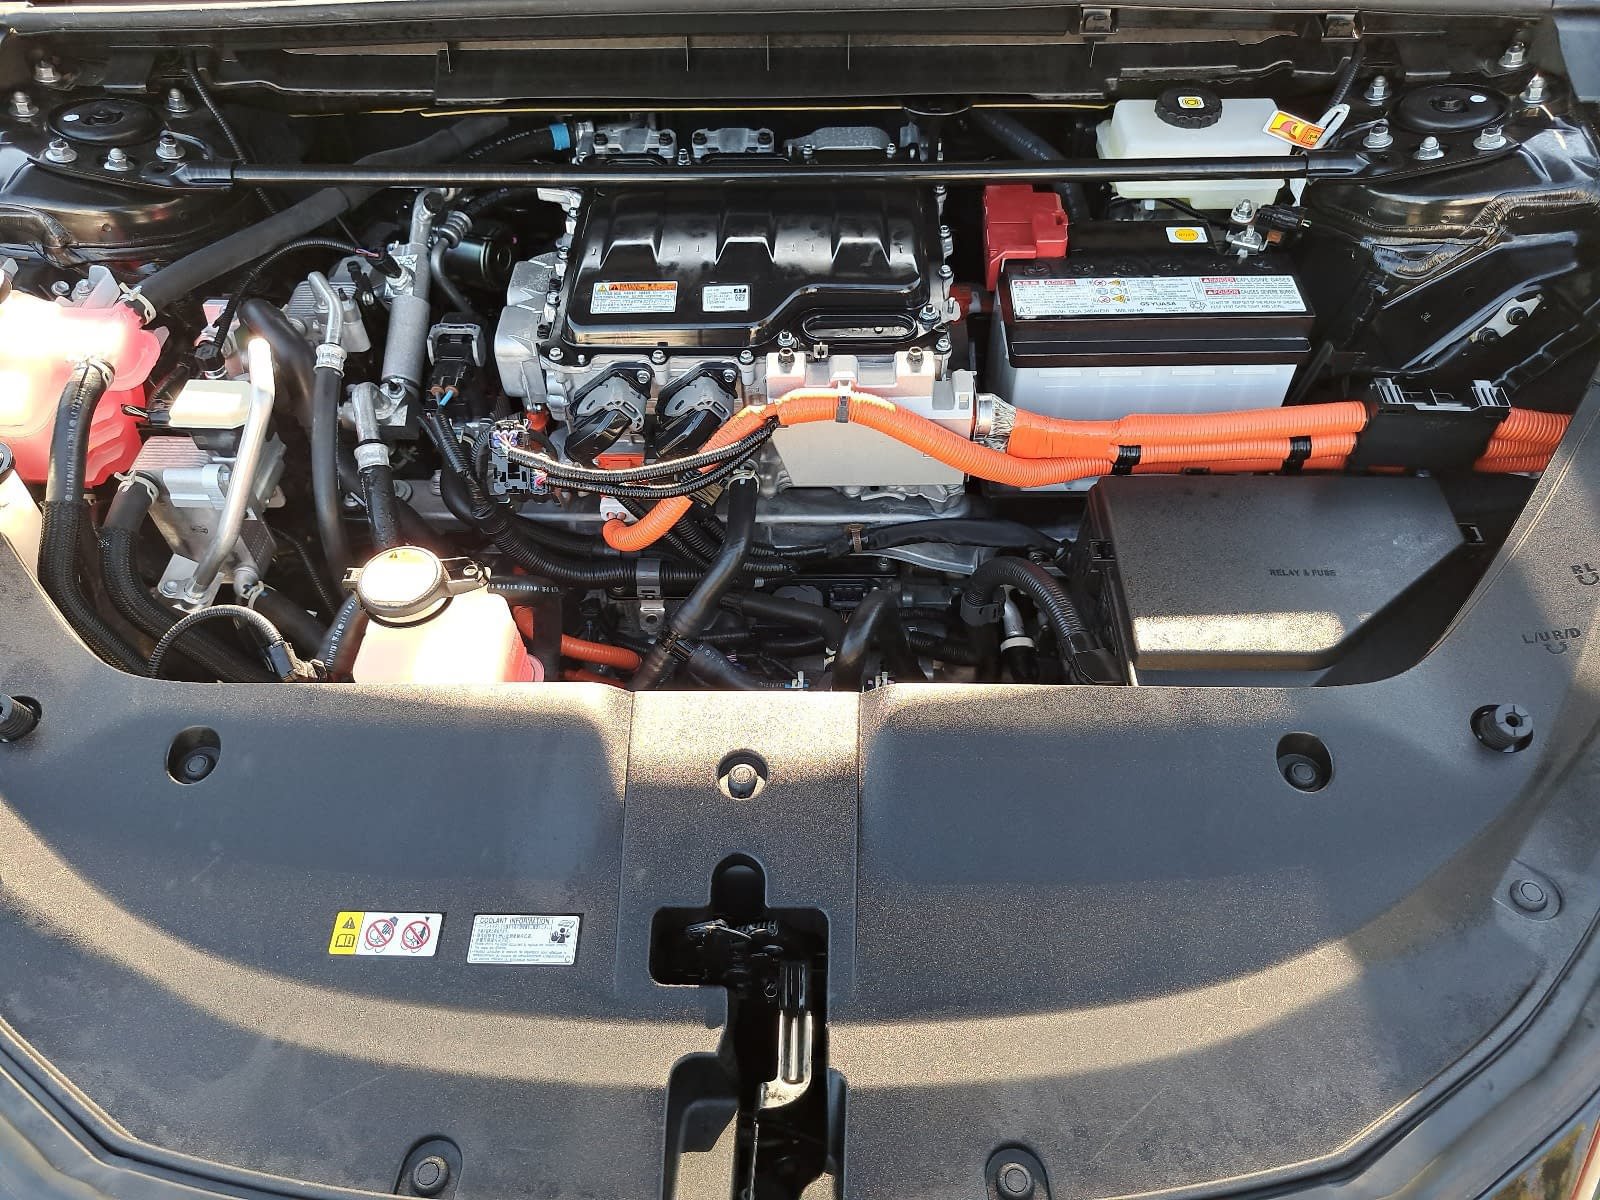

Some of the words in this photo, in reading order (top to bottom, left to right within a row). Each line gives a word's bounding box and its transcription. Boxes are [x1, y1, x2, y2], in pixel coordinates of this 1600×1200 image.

[1268, 568, 1300, 577] RELAY
[1311, 568, 1337, 577] FUSE
[1521, 631, 1550, 644] L/U
[1552, 627, 1581, 641] R/D
